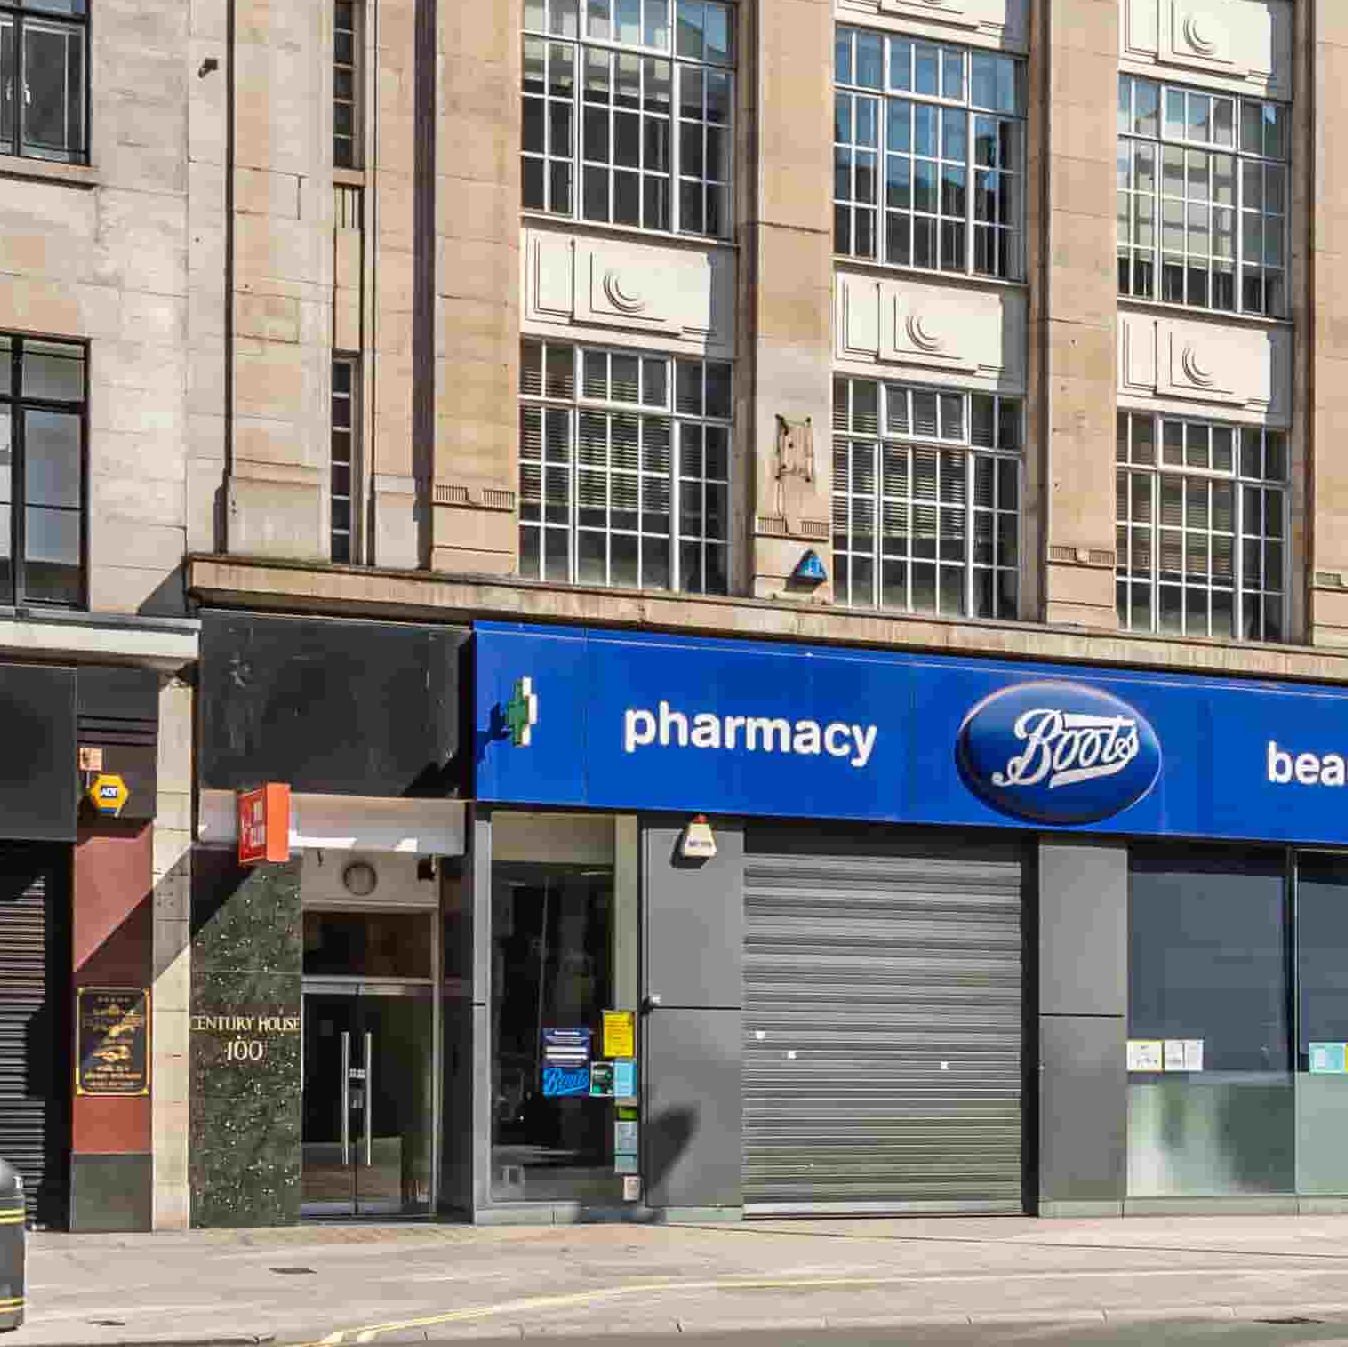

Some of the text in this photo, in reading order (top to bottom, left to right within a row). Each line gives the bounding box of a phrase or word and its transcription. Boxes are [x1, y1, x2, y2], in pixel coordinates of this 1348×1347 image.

[624, 701, 878, 766] pharmacy
[991, 708, 1140, 788] Boots
[190, 1015, 301, 1032] CENTURY HOUSE
